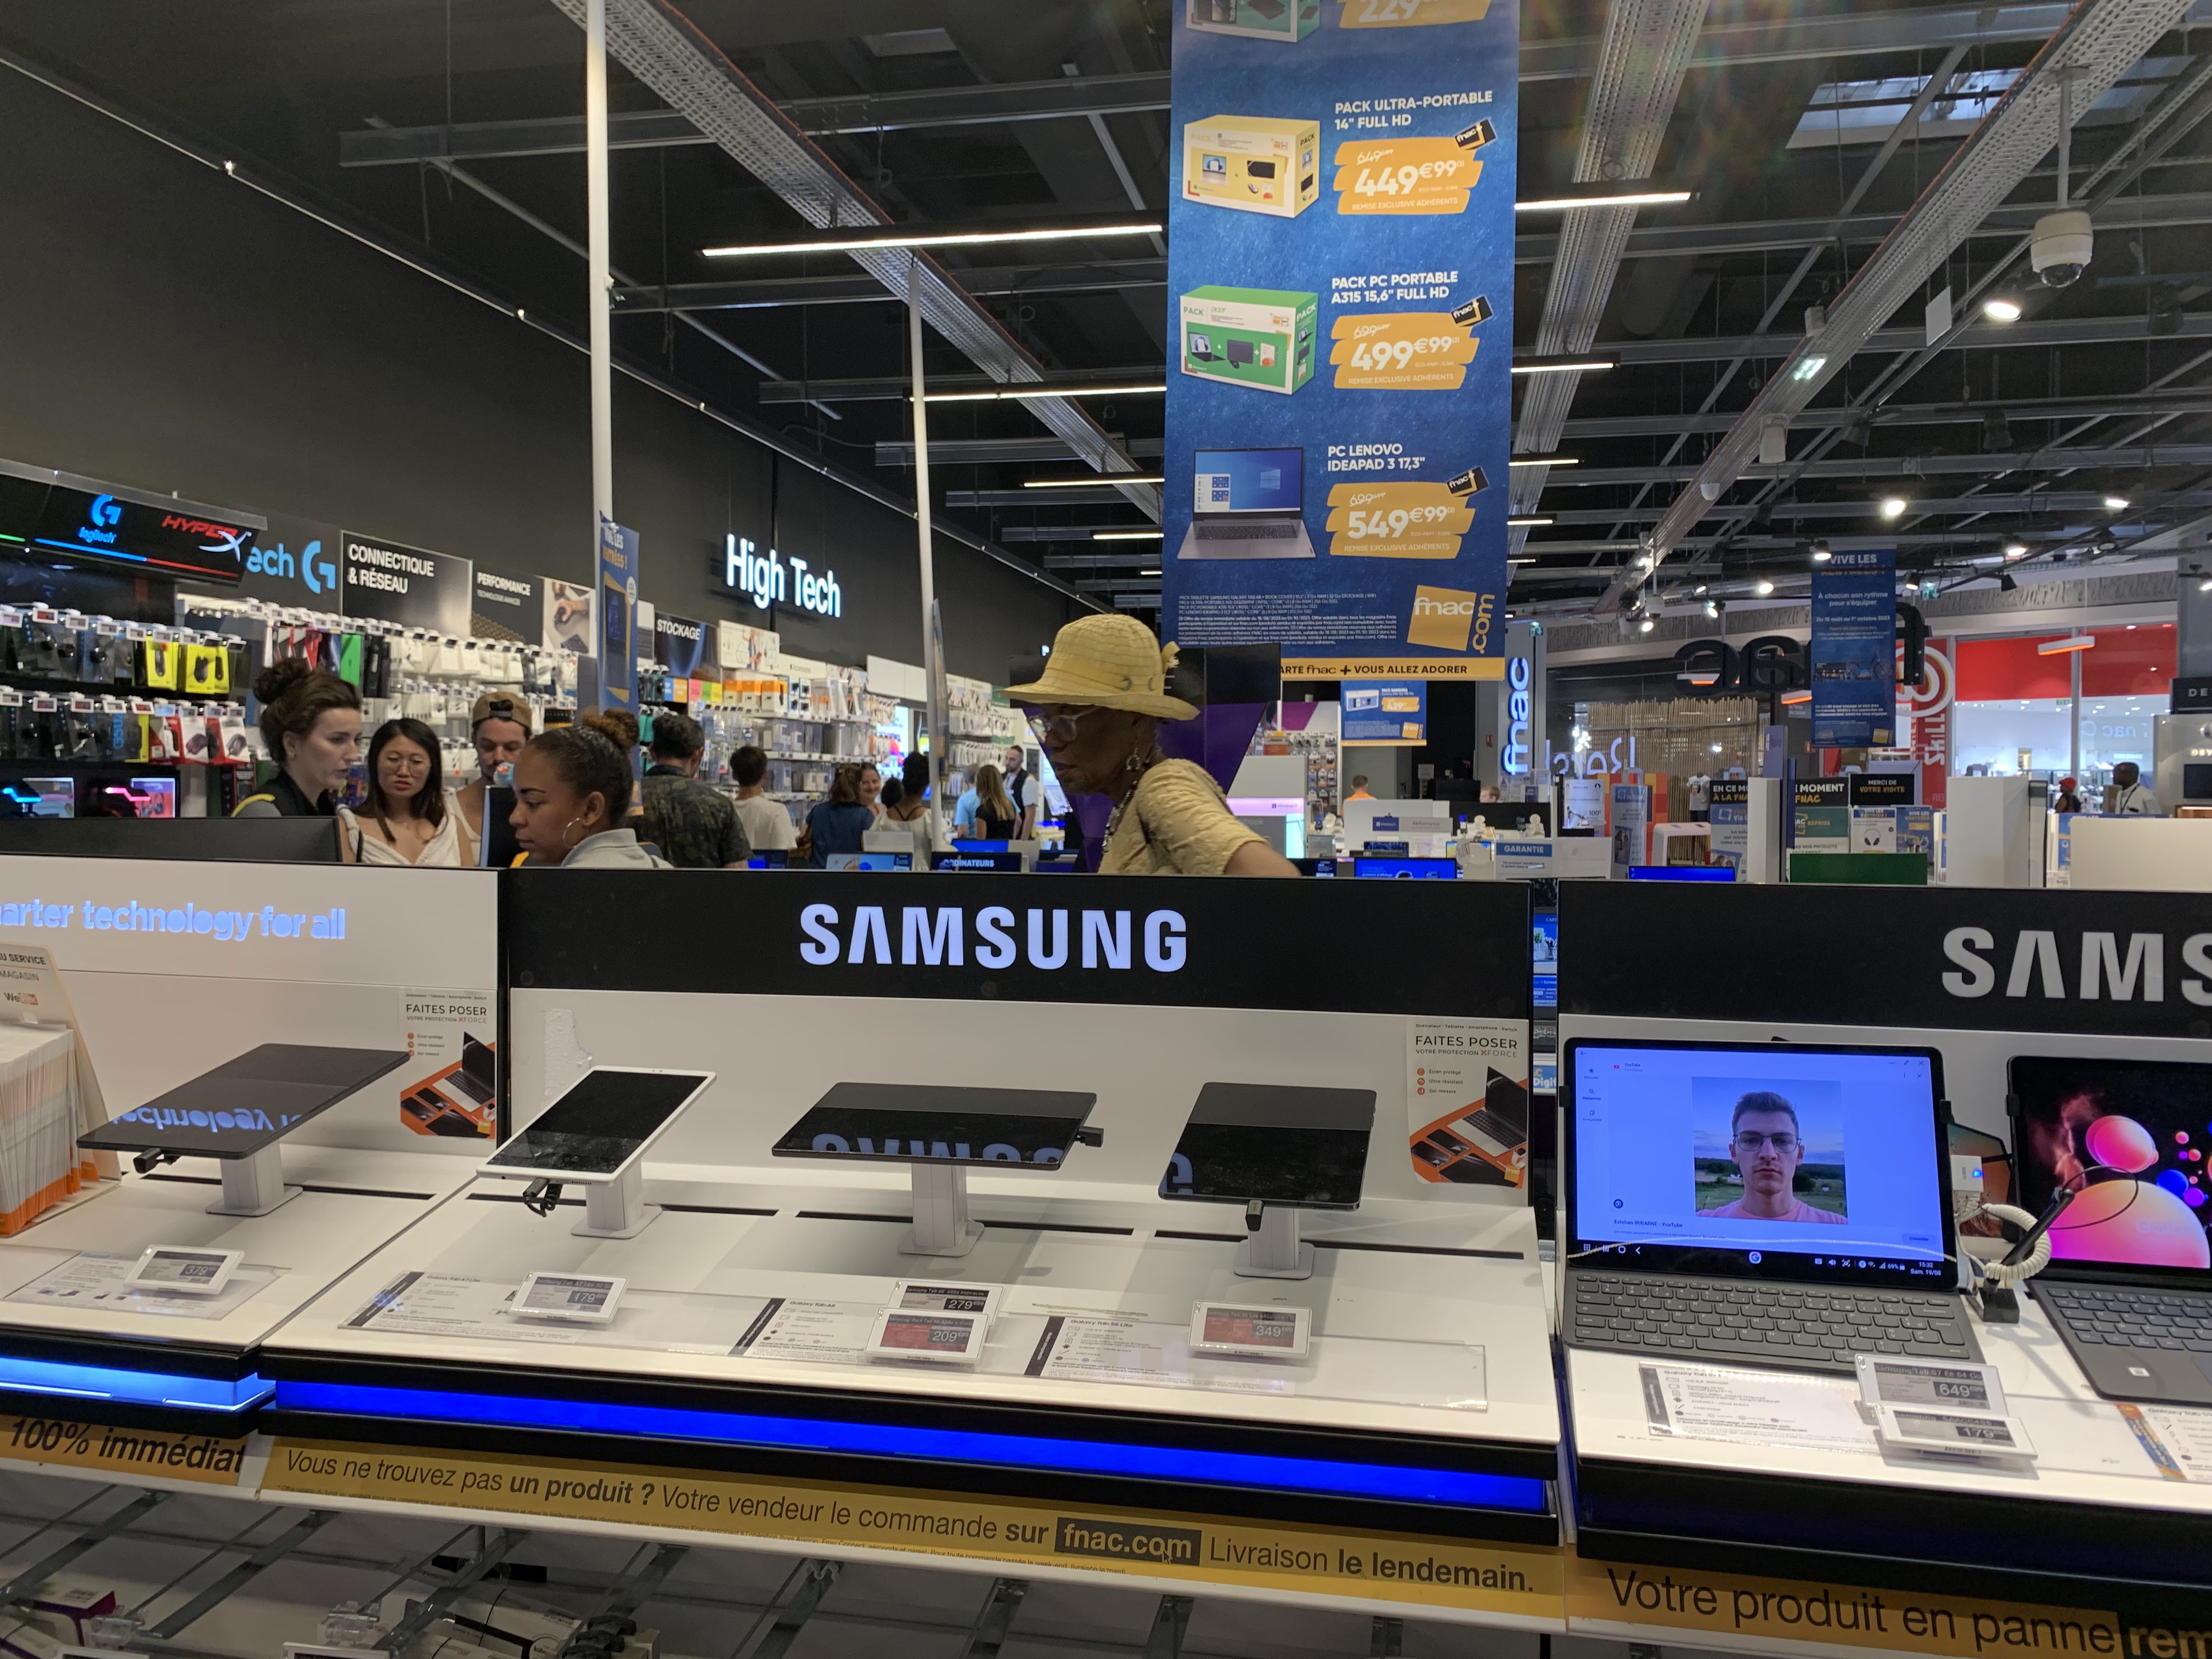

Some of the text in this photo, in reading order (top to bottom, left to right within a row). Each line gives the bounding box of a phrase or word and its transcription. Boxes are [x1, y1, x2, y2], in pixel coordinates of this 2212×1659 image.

[1335, 91, 1493, 114] PACK ULTRA-PORTABLE
[1335, 114, 1412, 130] 14" FULL HD
[1300, 132, 1315, 146] PACK
[1352, 196, 1458, 211] REMISE EXCLUSIVE ADHÉRENTS
[1332, 270, 1458, 289] PACK PC PORTABLE
[1331, 286, 1449, 304] A315 15,6" FULL HD
[1183, 307, 1204, 316] PACK
[1296, 302, 1317, 321] PACK
[1374, 375, 1411, 383] EXCLUSIVE
[1413, 373, 1454, 382] ADHÉRENTS
[1328, 443, 1403, 457] PC LENOVO
[1328, 456, 1425, 472] IDEAPAD 3 17,3"
[78, 527, 116, 544] logitech
[614, 533, 624, 549] LES
[1408, 542, 1450, 551] ADHÉRENTS
[348, 544, 435, 577] CONNECTIQUE
[1830, 554, 1877, 564] VIVE LES
[347, 567, 408, 594] & RÉSEAU
[727, 533, 840, 618] High Tech
[477, 572, 531, 596] PERFORMANCE
[1413, 597, 1475, 616] fnac
[657, 618, 701, 641] STOCKAGE
[1307, 665, 1336, 674] fnac
[1355, 665, 1384, 674] VOUS
[1387, 665, 1418, 674] ALLEZ
[1421, 665, 1467, 674] ADORER
[2188, 689, 2212, 697] DE
[1502, 658, 1529, 776] fnac
[1800, 783, 1844, 793] MOMENT
[1796, 795, 1821, 803] FNAC
[82, 900, 254, 942] technology
[260, 905, 307, 938] for
[311, 909, 346, 940] all
[800, 904, 1186, 972] SAMSUNG
[9, 954, 46, 966] SERVICE
[1942, 927, 2212, 1006] SAMS
[0, 970, 39, 982] MAGASIN
[406, 1004, 487, 1015] FAITES POSER
[1416, 1036, 1517, 1049] FAITES POSER
[1481, 1049, 1517, 1058] XFORCE
[1874, 1363, 1912, 1374] Samsung
[1914, 1367, 1928, 1375] Tab
[9, 1417, 245, 1476] 100% immédiat
[287, 1450, 336, 1477] Vous
[343, 1459, 371, 1479] ne
[376, 1458, 456, 1487] trouvez
[461, 1470, 503, 1493] pas
[510, 1475, 538, 1494] un
[545, 1477, 633, 1505] produit
[642, 1483, 655, 1505] ?
[663, 1486, 719, 1514] Votre
[729, 1492, 823, 1523] vendeur
[831, 1499, 851, 1525] le
[859, 1506, 997, 1541] commande
[1006, 1521, 1049, 1544] sur
[1064, 1523, 1192, 1560] fnac.com
[1210, 1537, 1328, 1571] Livraison
[1339, 1549, 1362, 1575] le
[1372, 1551, 1534, 1592] lendemain.
[1607, 1568, 2212, 1659] Votre produit en panne rem
